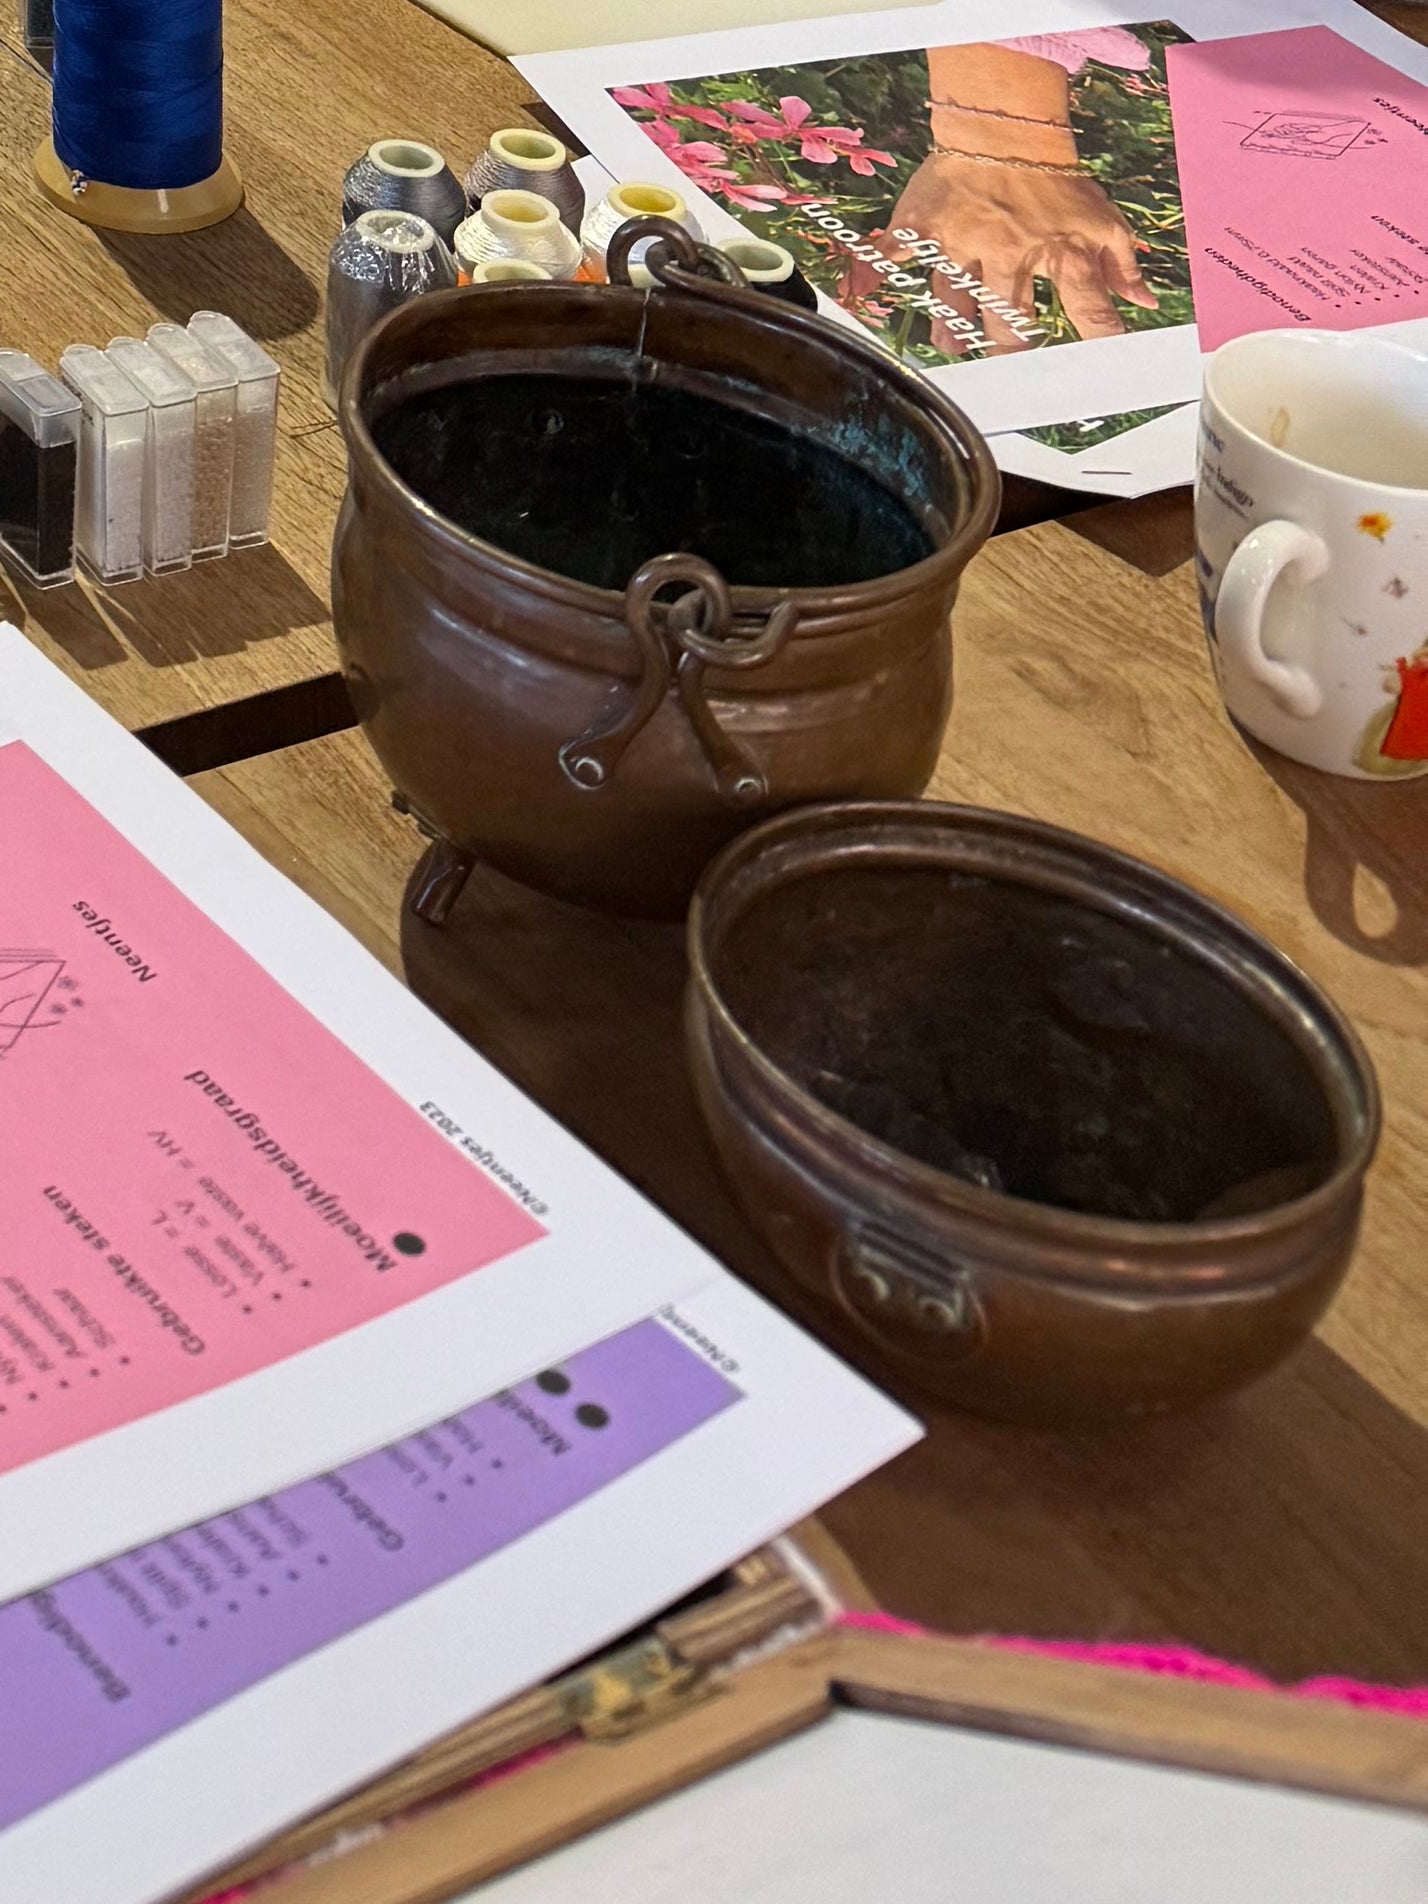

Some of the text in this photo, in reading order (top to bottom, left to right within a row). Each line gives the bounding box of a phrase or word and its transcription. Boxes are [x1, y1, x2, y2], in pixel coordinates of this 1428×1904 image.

[800, 203, 997, 353] Haak patroon
[892, 227, 1046, 342] Twinkeltje
[73, 901, 157, 982] Neentjes
[184, 1070, 396, 1272] Moeilijkheidsgraad
[420, 1102, 462, 1145] 2023
[43, 1186, 205, 1355] Gebruikte steken
[53, 1289, 115, 1349] Schaar
